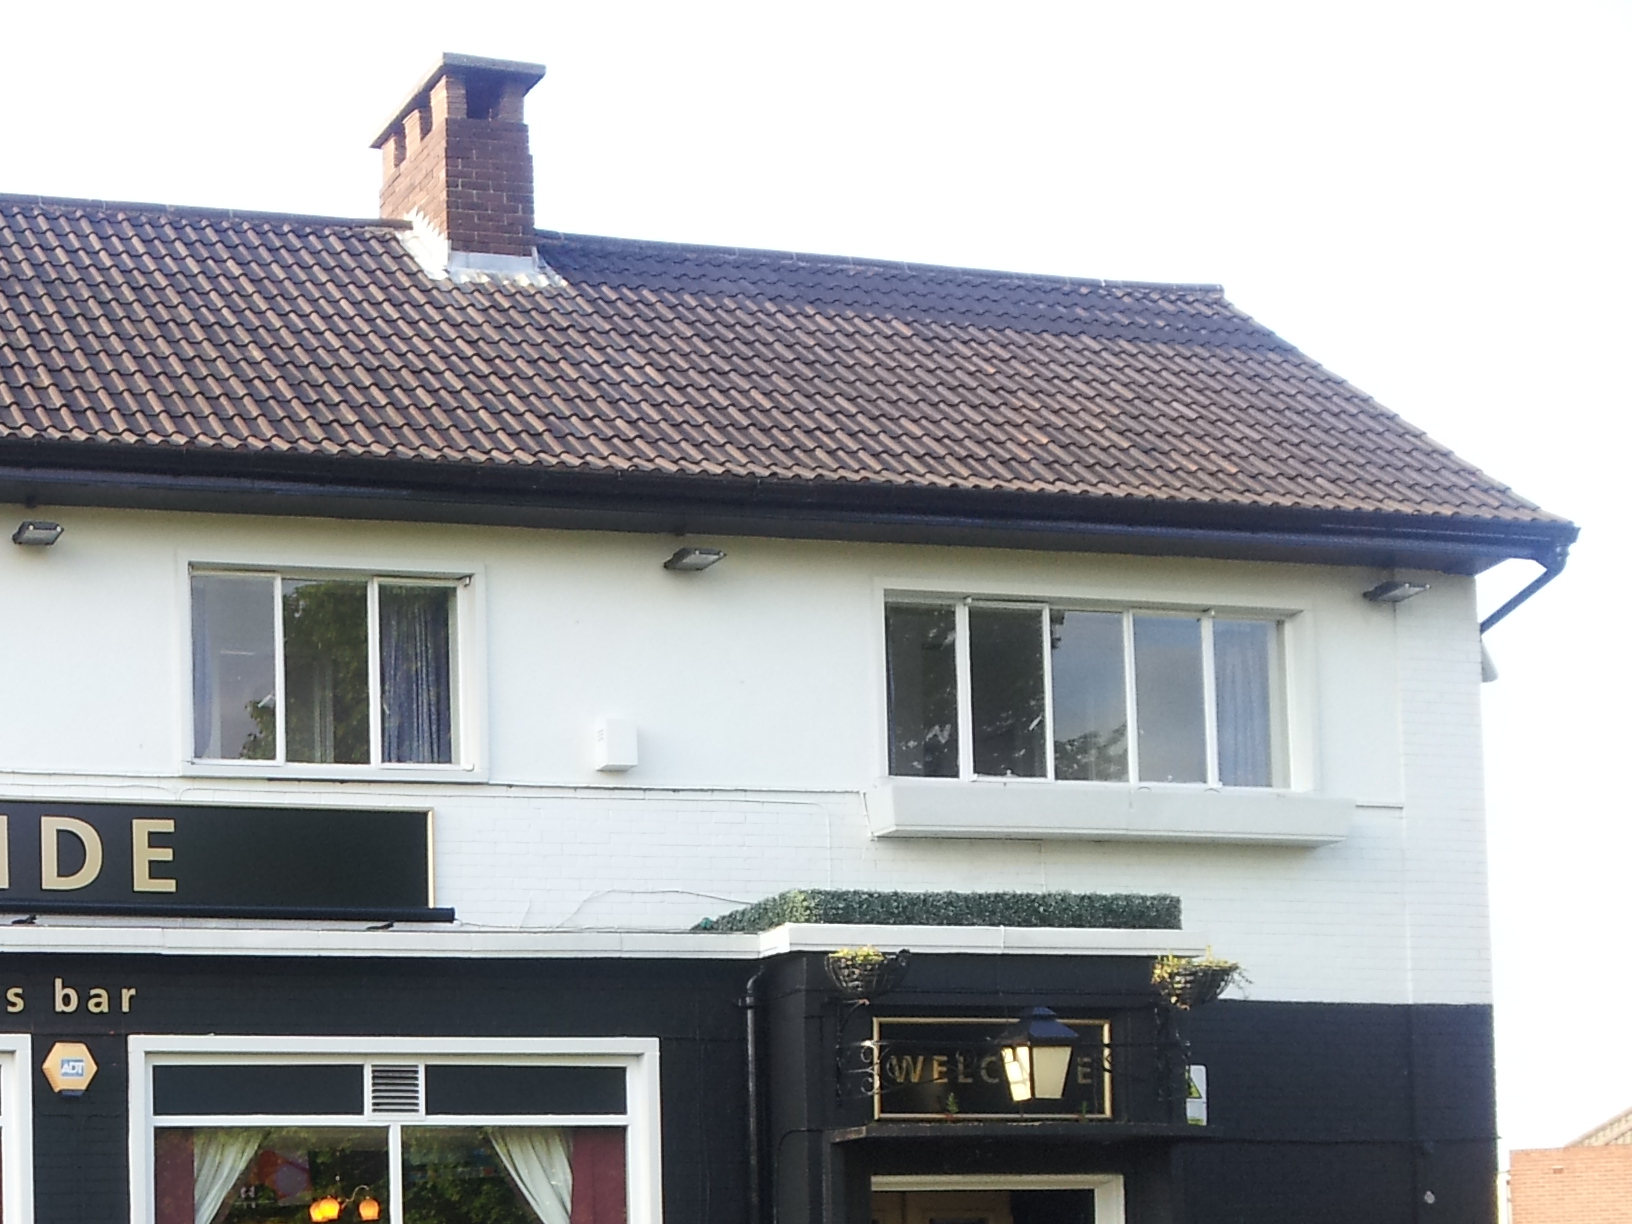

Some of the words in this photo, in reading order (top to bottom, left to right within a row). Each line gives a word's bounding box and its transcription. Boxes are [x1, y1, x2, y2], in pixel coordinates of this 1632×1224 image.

[54, 977, 137, 1014] bar
[61, 1061, 84, 1074] ADT
[889, 1055, 1092, 1084] WELCE
